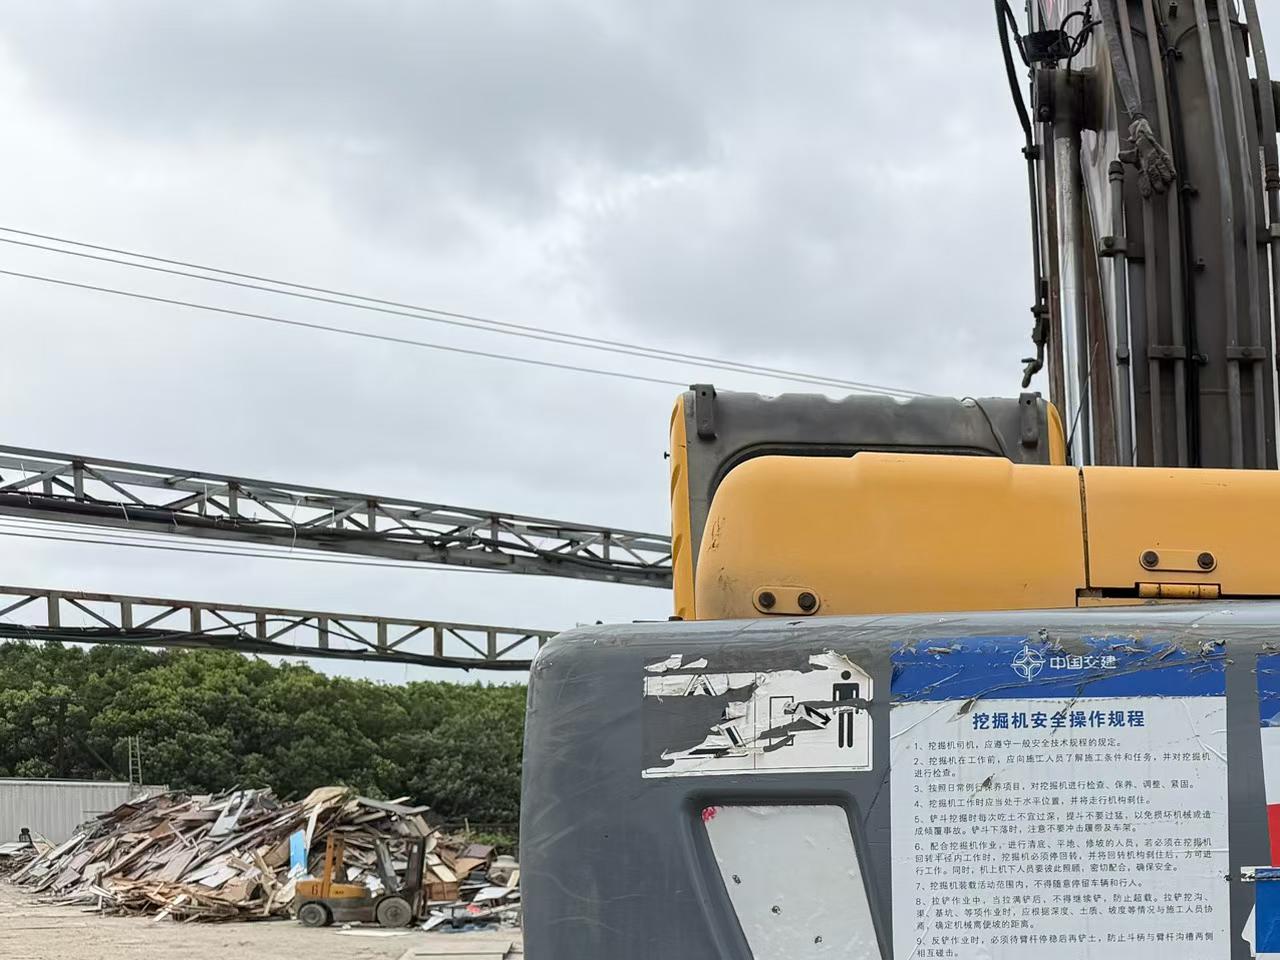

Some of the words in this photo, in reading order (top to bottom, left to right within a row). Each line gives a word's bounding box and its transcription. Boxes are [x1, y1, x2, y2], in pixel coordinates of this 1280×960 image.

[1050, 655, 1117, 670] 中国交建
[972, 710, 1145, 730] 挖掘机安全操作规程
